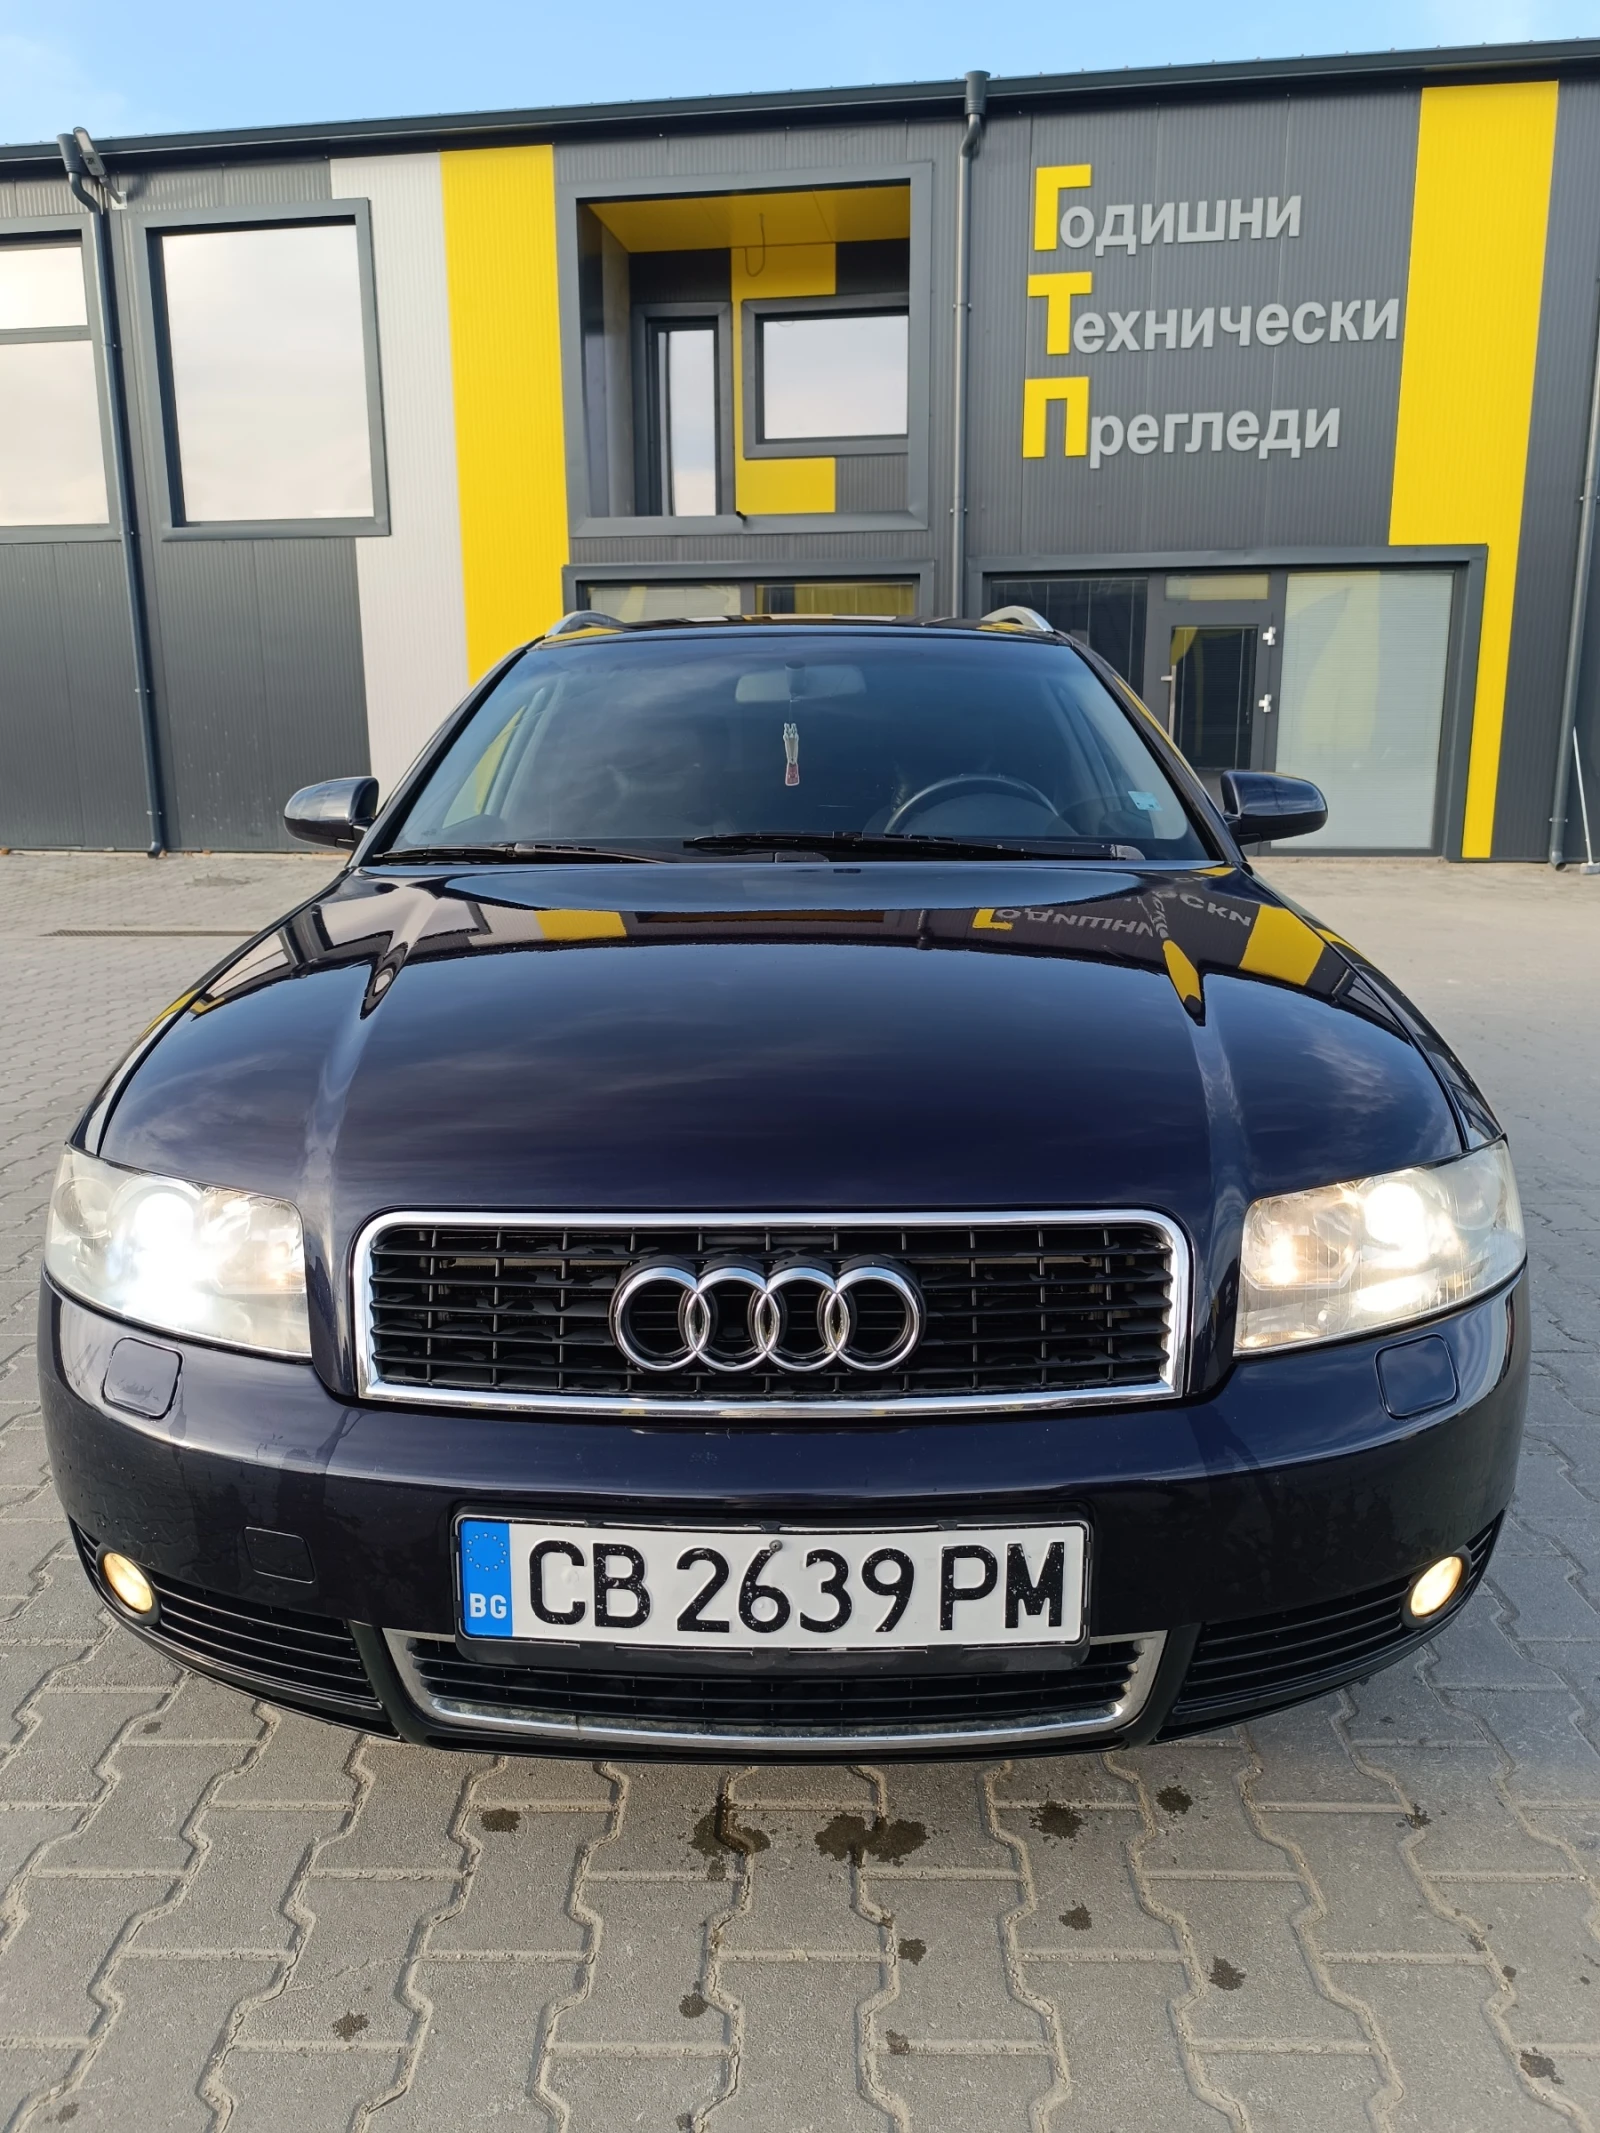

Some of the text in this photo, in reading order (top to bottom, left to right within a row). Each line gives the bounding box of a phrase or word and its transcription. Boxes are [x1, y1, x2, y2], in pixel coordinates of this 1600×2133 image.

[1034, 164, 1302, 257] Годишни
[1027, 271, 1400, 355] Технически
[1022, 376, 1341, 469] Прегледи
[469, 1592, 507, 1619] BG
[529, 1540, 1065, 1634] CB 2639 PM
